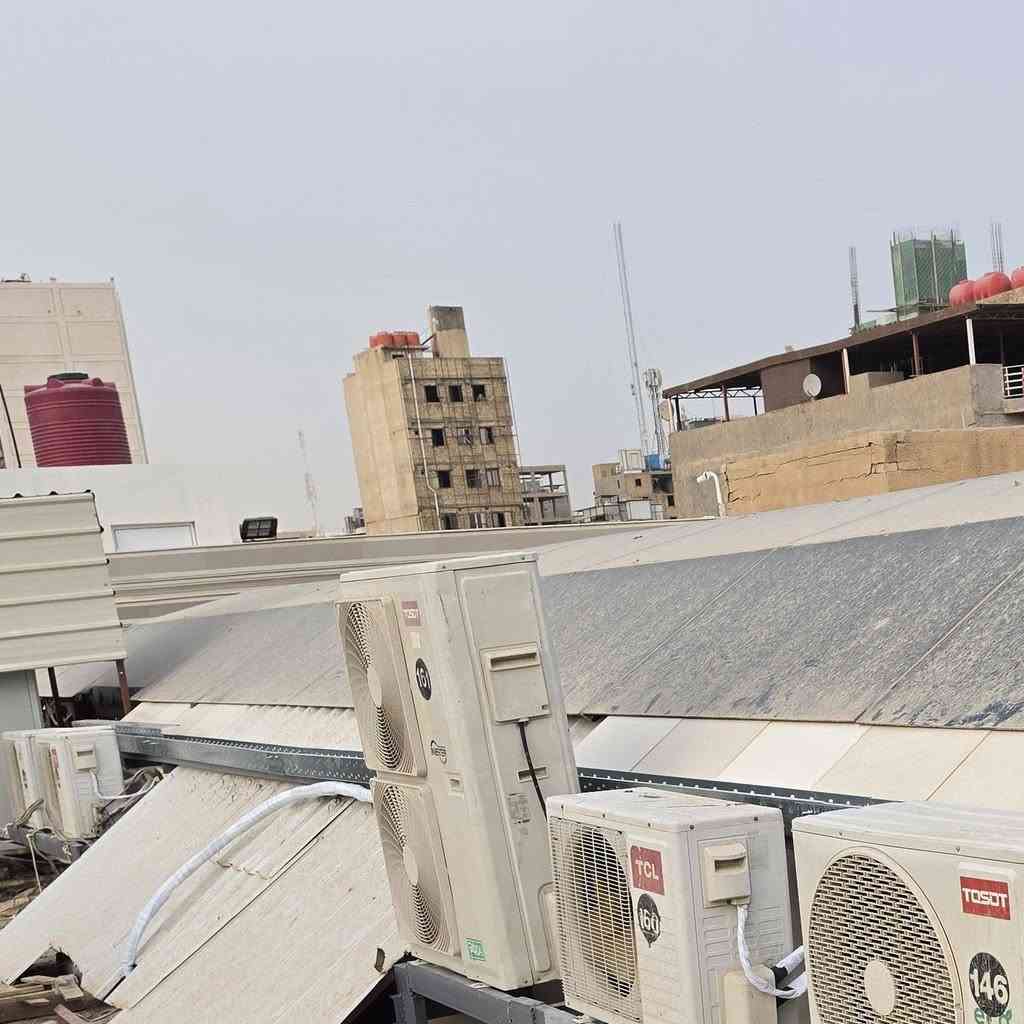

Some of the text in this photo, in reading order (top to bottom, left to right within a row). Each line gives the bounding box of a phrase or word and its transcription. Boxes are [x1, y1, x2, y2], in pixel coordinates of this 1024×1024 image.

[416, 666, 431, 691] 161
[635, 858, 659, 880] TCL
[961, 887, 1008, 908] TOSOT
[969, 967, 1009, 1005] 146
